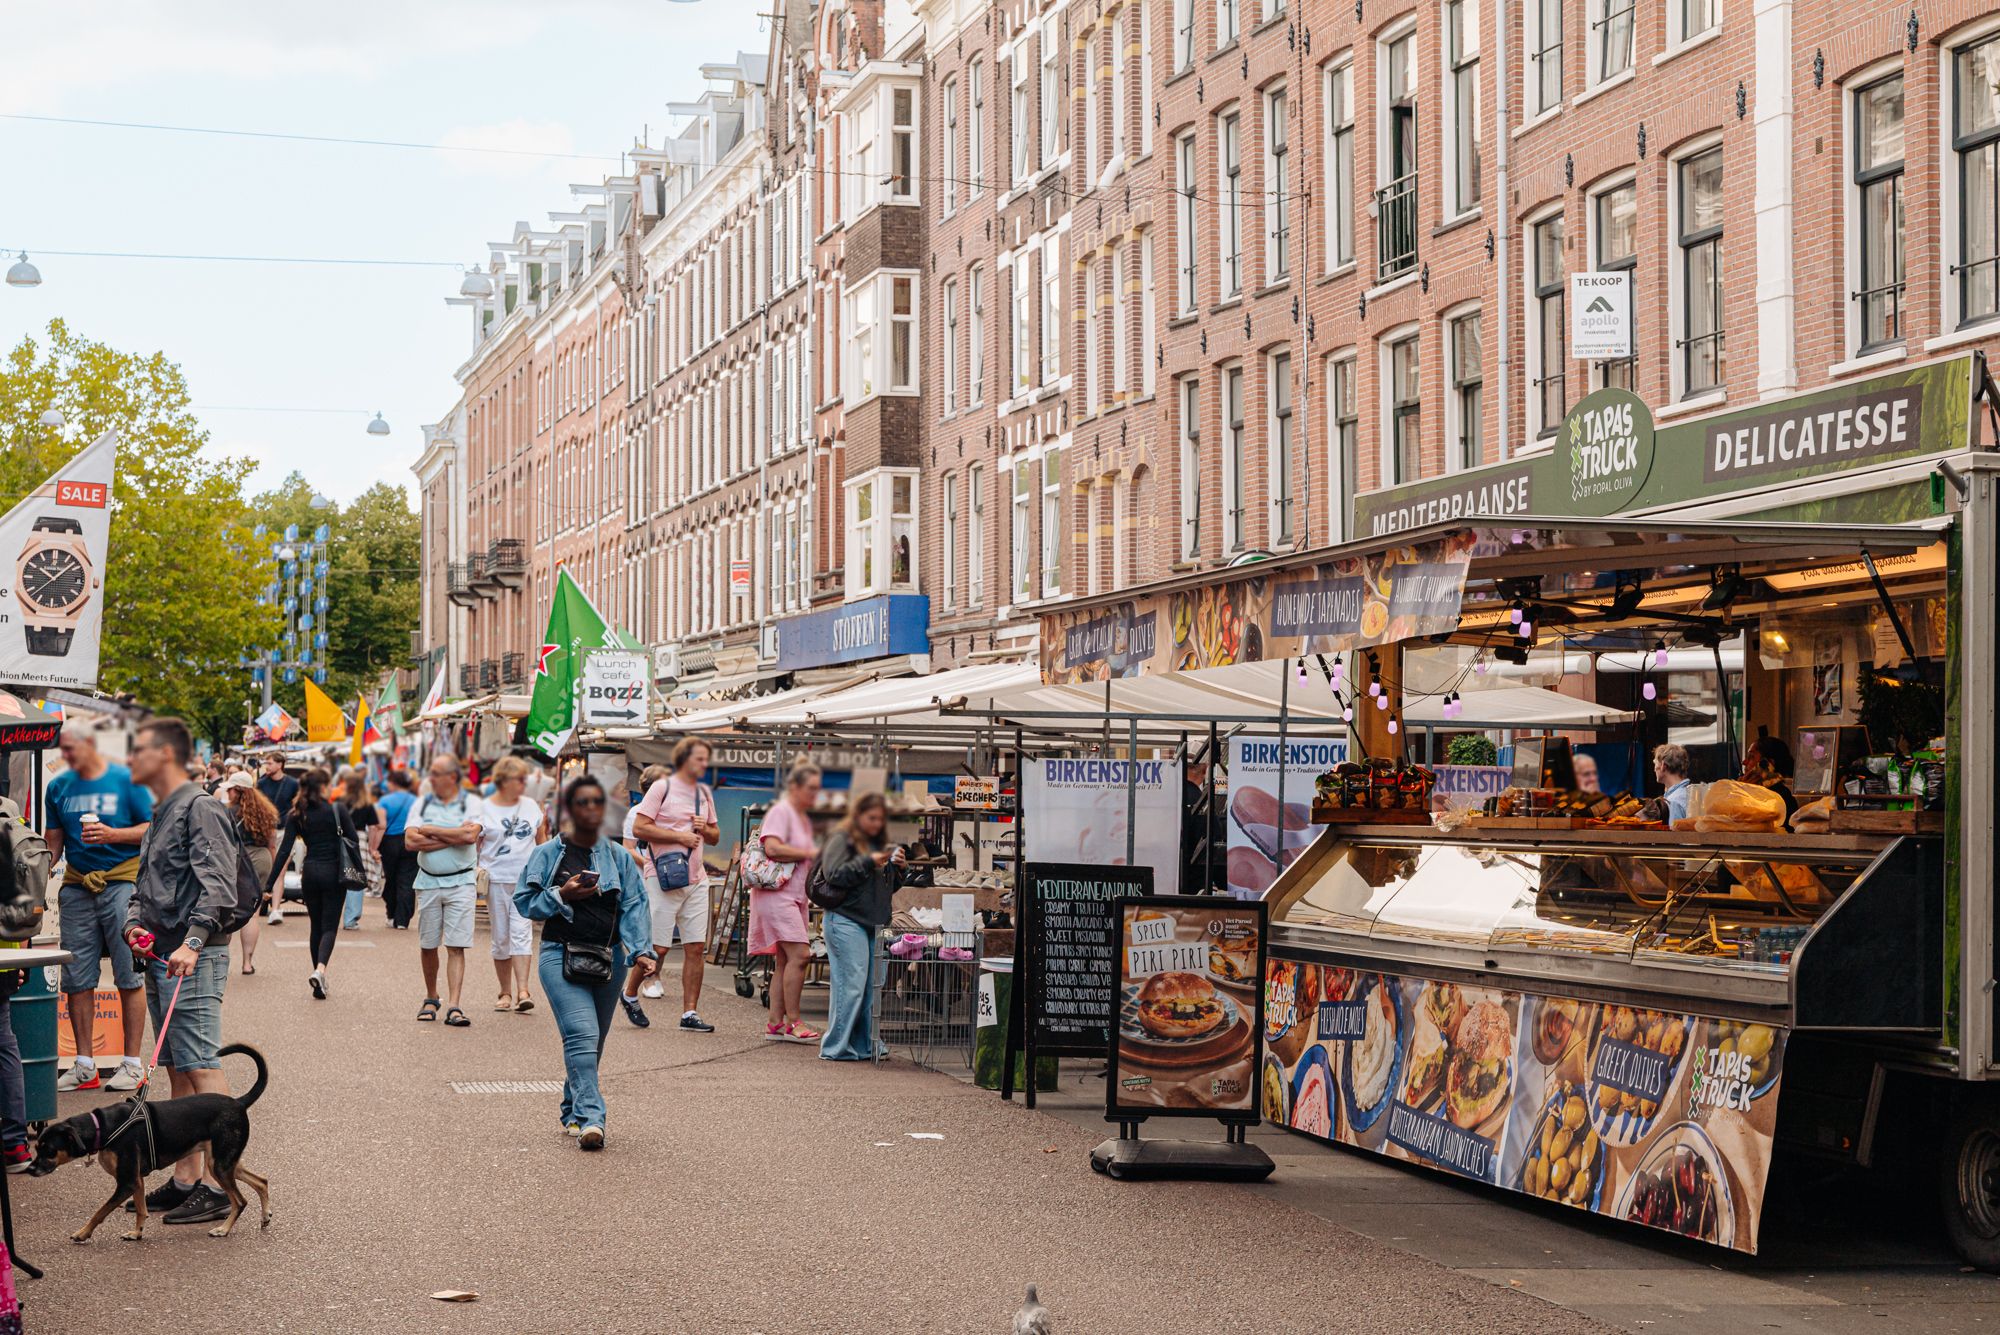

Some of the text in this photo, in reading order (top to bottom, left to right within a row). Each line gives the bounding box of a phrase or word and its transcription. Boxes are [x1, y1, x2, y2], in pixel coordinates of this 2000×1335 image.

[1577, 277, 1622, 286] TE KOOP
[1581, 315, 1619, 329] apollo
[1584, 403, 1633, 445] TAPAS
[1714, 399, 1908, 472] DELICATESSE
[1581, 435, 1638, 480] TRUCK
[61, 486, 102, 503] SALE
[1584, 477, 1633, 497] BY POPAL OLIVA
[1373, 476, 1529, 536] MEDITERRAANSE
[1318, 588, 1360, 624] TAPENADES
[833, 611, 875, 651] STOFFEN
[1129, 621, 1155, 655] OLIVES
[596, 659, 637, 669] Lunch
[602, 669, 631, 680] café
[21, 672, 48, 682] Meets
[49, 674, 78, 684] Future
[1242, 743, 1347, 765] BIRKENSTOCK
[1046, 760, 1162, 784] BIRKENSTOCK
[1037, 880, 1114, 901] MEDITERRANEAN
[1137, 922, 1167, 941] SPICY
[1133, 947, 1203, 973] PIRI PIRI
[1272, 981, 1295, 1005] TAPAS
[1269, 1002, 1298, 1027] TRUCK
[1596, 1043, 1664, 1096] GREEK OLIVES
[1709, 1048, 1752, 1083] TAPAS
[1219, 1079, 1241, 1087] TAPAS
[1700, 1075, 1755, 1113] TRUCK
[1440, 1128, 1488, 1177] SANDWICHES
